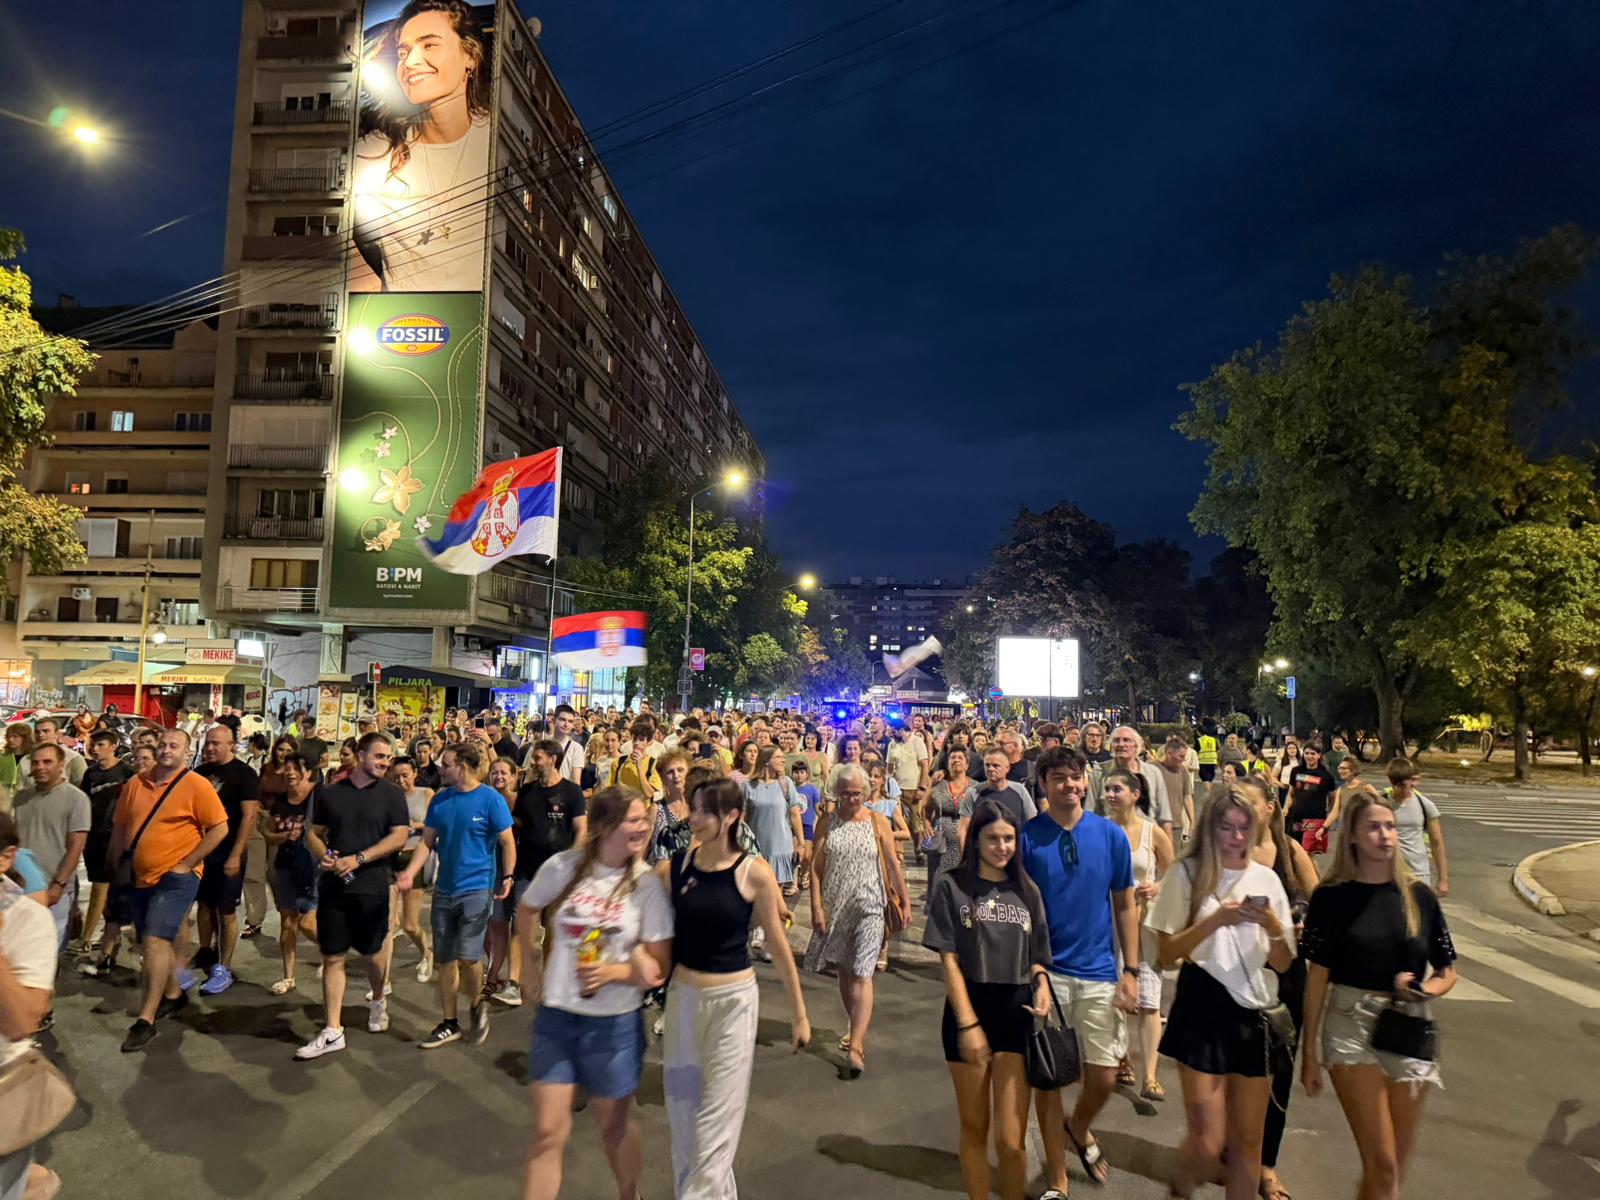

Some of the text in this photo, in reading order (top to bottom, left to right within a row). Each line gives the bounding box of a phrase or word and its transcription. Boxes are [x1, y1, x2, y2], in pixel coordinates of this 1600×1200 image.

[381, 328, 444, 342] FOSSIL
[203, 650, 233, 660] MEKIKE
[388, 677, 433, 687] PILJARA
